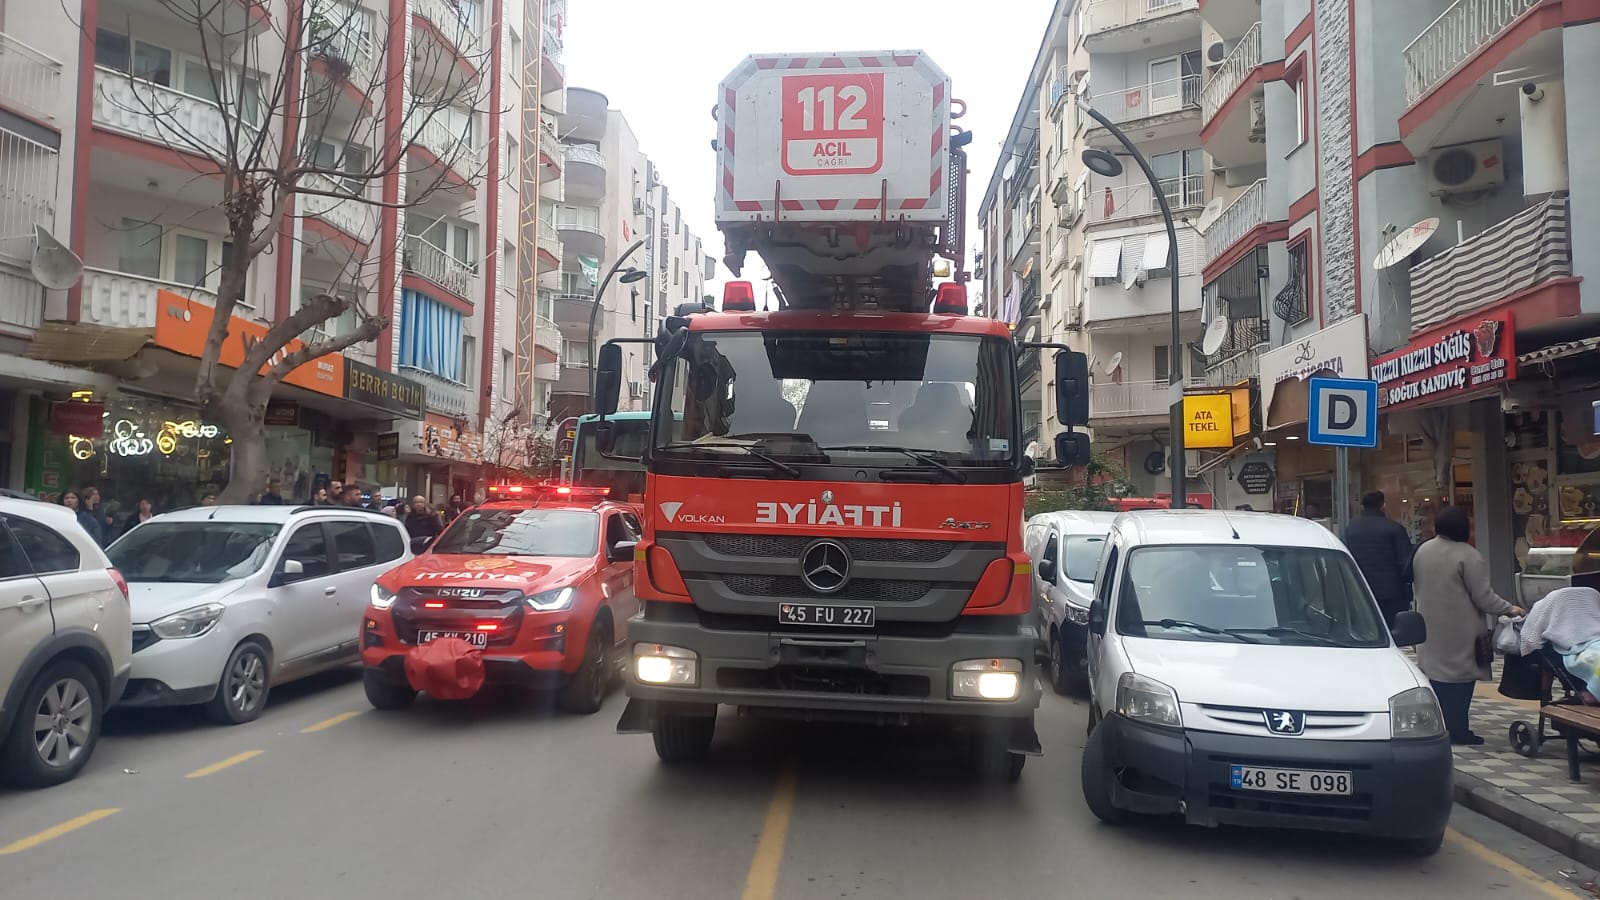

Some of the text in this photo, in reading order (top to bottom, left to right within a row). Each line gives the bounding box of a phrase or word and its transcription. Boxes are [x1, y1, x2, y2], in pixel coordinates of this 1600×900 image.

[797, 85, 868, 132] 112
[1371, 330, 1471, 384] KUZZU KUZZU SÖĞÜŞ
[352, 369, 388, 398] BERRA
[392, 382, 420, 407] BUTİK
[1389, 378, 1420, 405] SOĞUK
[1421, 367, 1466, 393] SANDVİÇ
[1194, 411, 1213, 420] ATA
[1327, 394, 1358, 430] D
[1188, 420, 1219, 432] TEKEL
[677, 514, 725, 524] VOLKAN
[437, 589, 480, 597] ISUZU
[787, 607, 872, 624] 45 FU 227
[464, 633, 484, 645] 210
[1242, 770, 1347, 793] 48 SE 098
